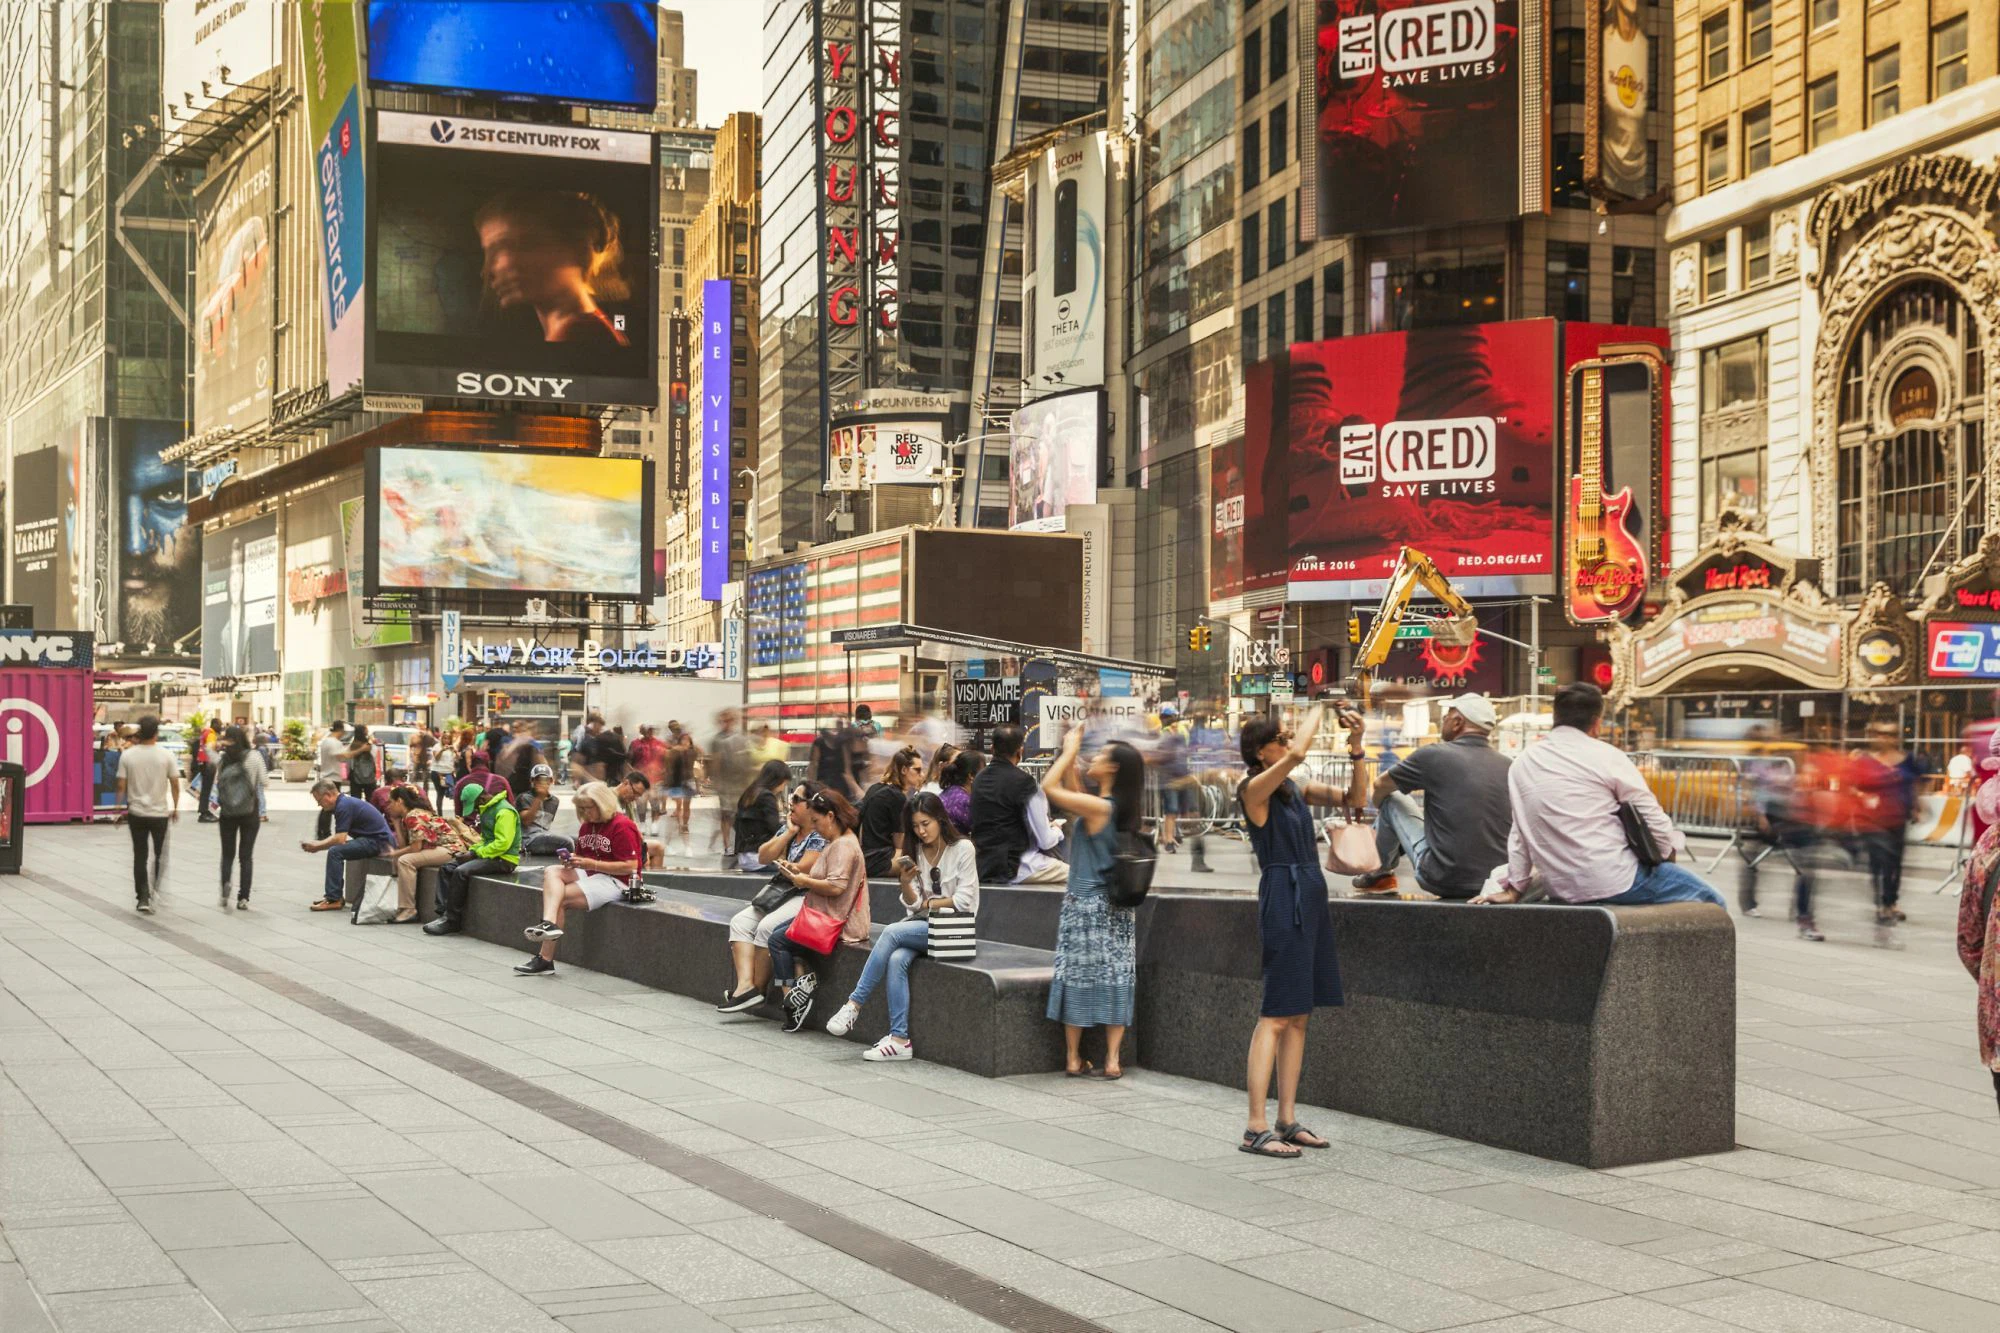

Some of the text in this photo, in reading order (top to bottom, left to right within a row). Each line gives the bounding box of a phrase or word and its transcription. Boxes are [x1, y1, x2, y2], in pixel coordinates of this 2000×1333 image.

[1385, 6, 1487, 62] (RED)
[1382, 60, 1495, 88] SAVE LIVES
[461, 127, 601, 151] 21ST CENTURY FOX
[825, 43, 859, 325] YOUNG
[320, 131, 348, 321] rewards
[712, 321, 722, 359] BE
[1051, 320, 1080, 336] THETA
[456, 372, 573, 398] SONY
[365, 400, 421, 411] SHERWOOD
[895, 433, 919, 444] RED
[1385, 424, 1488, 473] (RED)
[895, 455, 919, 466] DAY
[711, 395, 722, 554] VISIBLE
[1382, 480, 1496, 498] SAVE LIVES
[1295, 560, 1356, 572] JUNE 2016
[1457, 553, 1543, 566] RED.ORG/EAT
[1575, 568, 1645, 588] Hard Rock
[1705, 562, 1771, 591] Hard Rock
[371, 601, 417, 609] SHERWOOD
[447, 613, 456, 673] NYPD
[1409, 628, 1423, 636] Av
[0, 635, 73, 661] NYC
[729, 621, 738, 678] NYPD
[956, 683, 1020, 702] VISIONAIRE
[956, 703, 1012, 723] FREE ART
